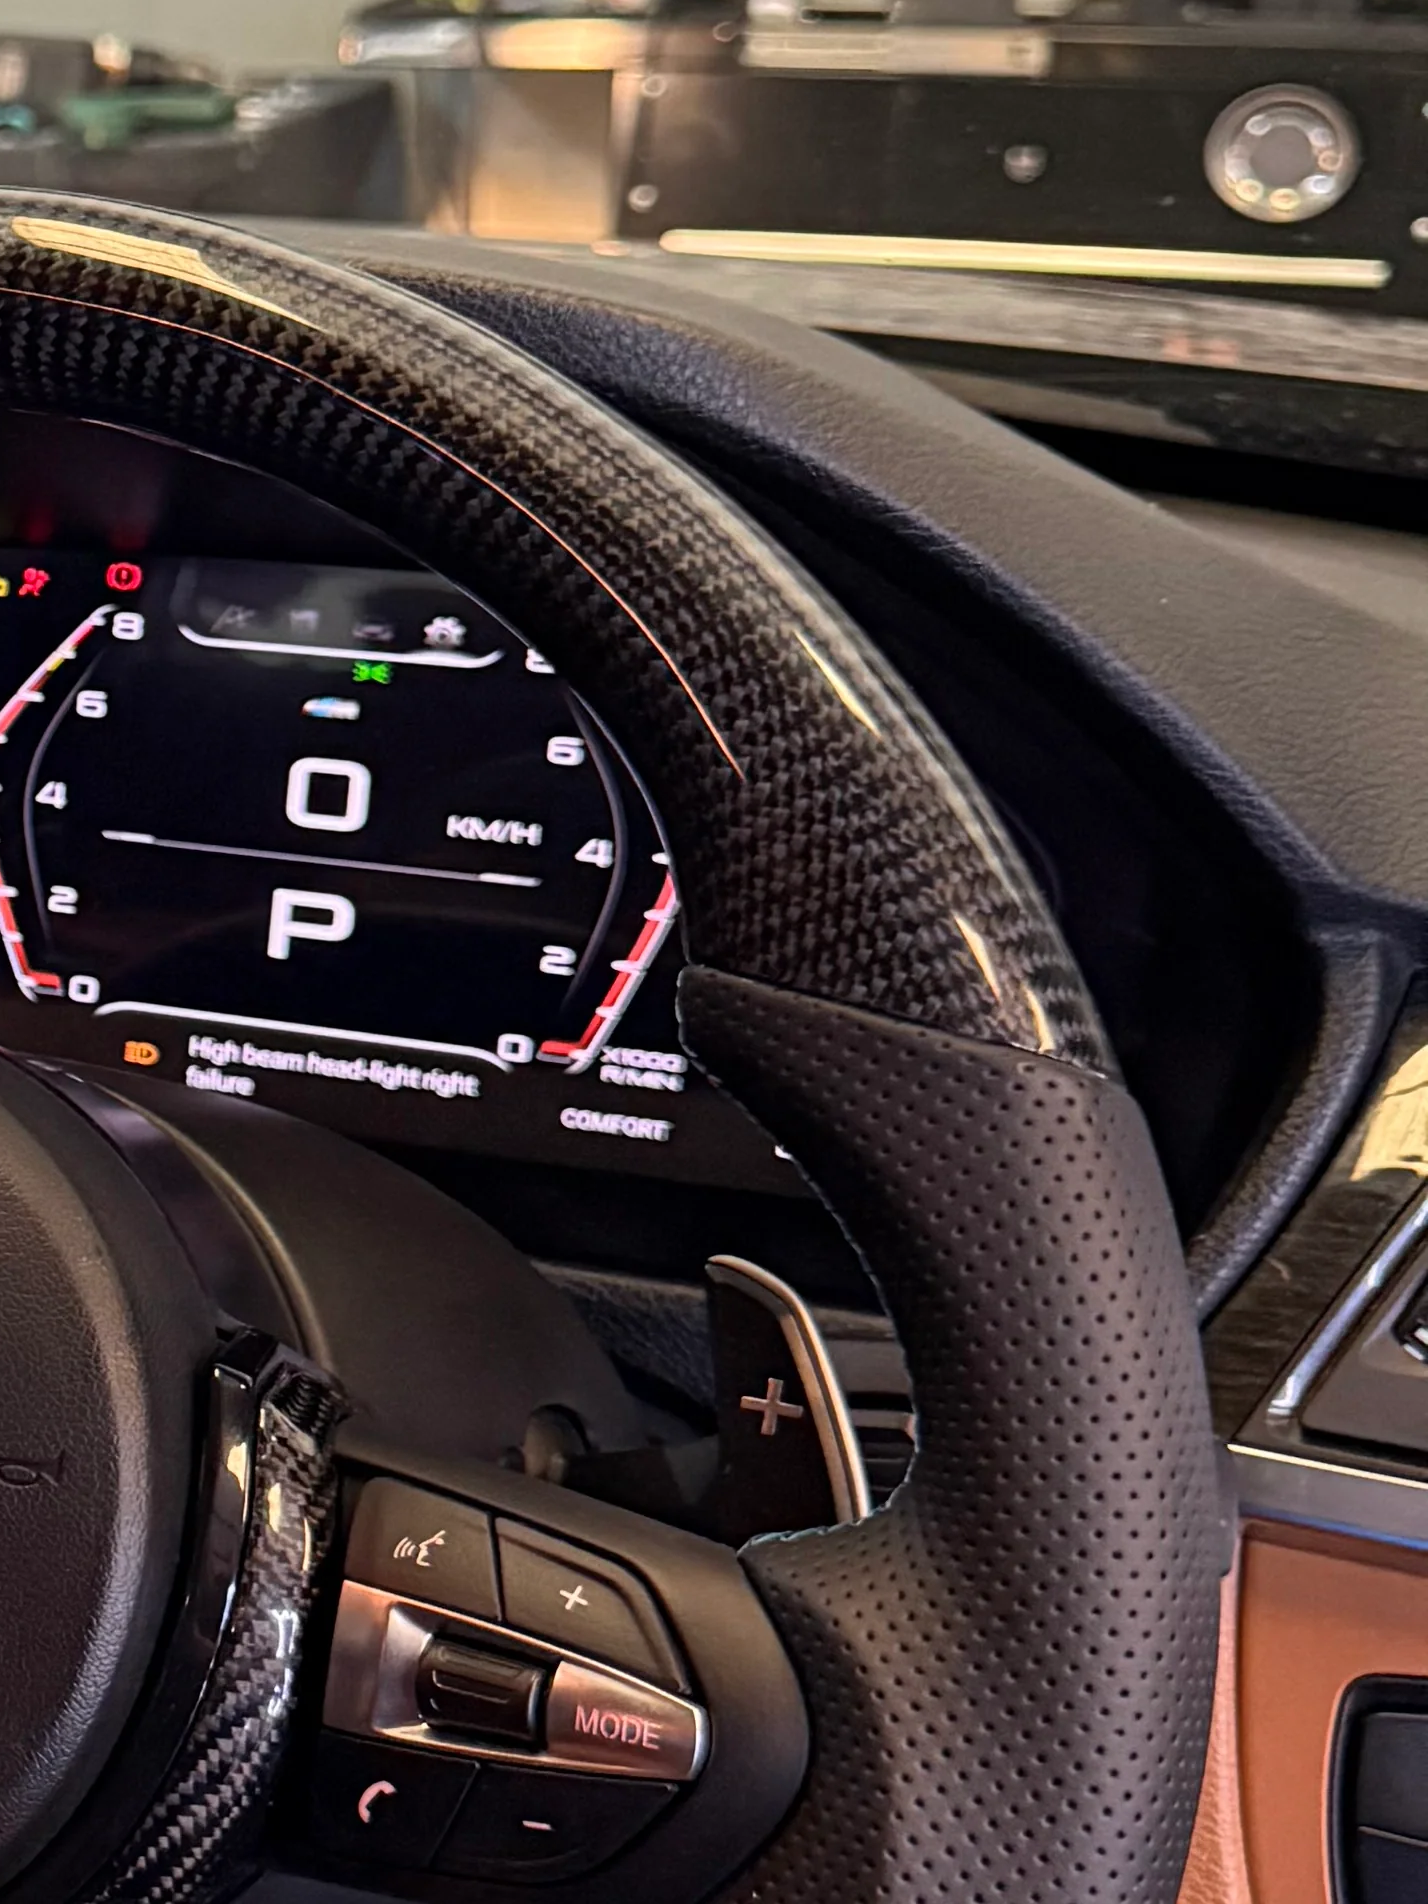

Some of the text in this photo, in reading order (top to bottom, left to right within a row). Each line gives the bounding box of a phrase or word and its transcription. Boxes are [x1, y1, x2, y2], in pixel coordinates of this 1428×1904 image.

[111, 611, 145, 641] 8
[75, 689, 108, 718] 6
[547, 736, 585, 766] 6
[35, 780, 68, 809] 4
[285, 757, 372, 832] 0
[446, 814, 543, 846] KM/H
[574, 838, 614, 868] 4
[47, 884, 79, 915] 2
[267, 888, 356, 960] P
[539, 945, 577, 976] 2
[68, 974, 100, 1004] 0
[497, 1033, 535, 1063] 0
[186, 1064, 256, 1097] failure
[188, 1034, 242, 1066] High
[242, 1041, 306, 1073] beam
[421, 1064, 481, 1099] right
[560, 1106, 674, 1143] COMFORT
[574, 1703, 662, 1751] MODE
